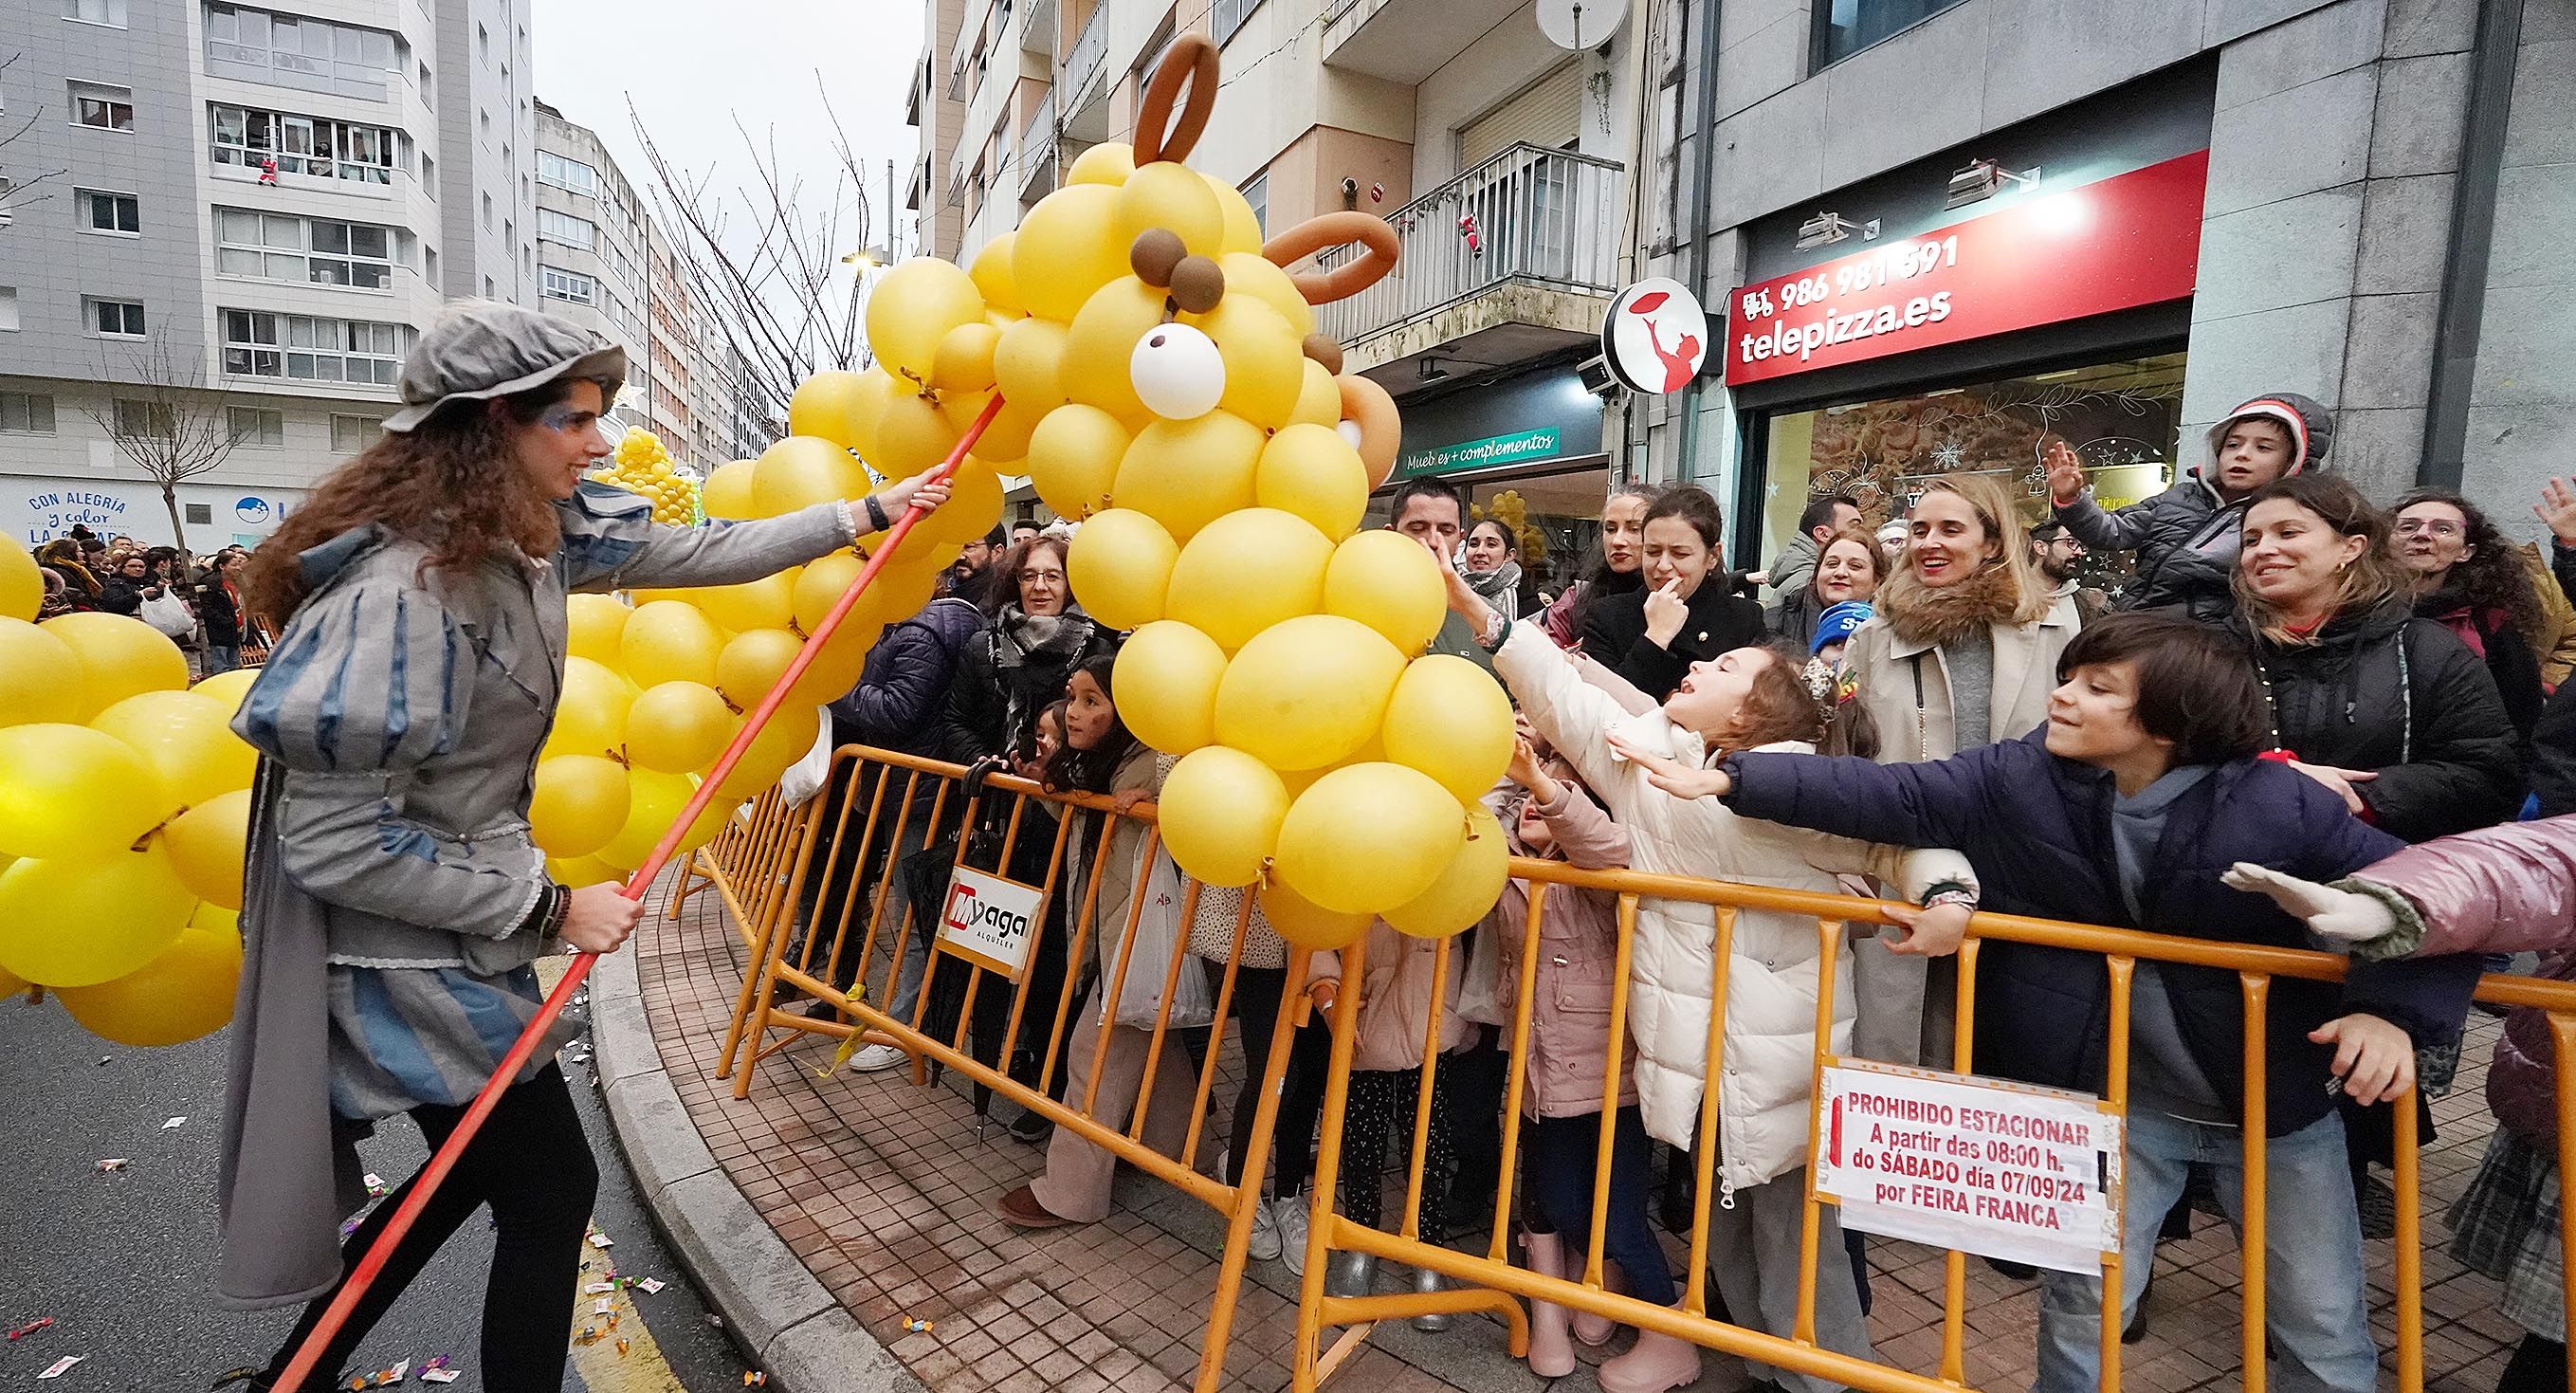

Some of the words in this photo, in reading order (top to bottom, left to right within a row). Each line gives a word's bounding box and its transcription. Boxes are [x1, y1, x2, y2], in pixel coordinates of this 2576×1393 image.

[1781, 273, 1829, 311] 986
[1836, 248, 1888, 296] 981
[1898, 235, 1958, 280] 591
[1740, 291, 1951, 362] telepizza.es
[1459, 433, 1555, 463] complementos
[28, 492, 60, 510] CON
[66, 492, 126, 514] ALEGRÍA
[48, 513, 59, 528] y
[65, 508, 110, 523] color
[29, 529, 50, 543] LA
[948, 890, 1027, 938] Myaga
[977, 931, 1014, 949] ALQUILER
[1848, 1091, 1953, 1127] PROHIBIDO
[1959, 1107, 2091, 1147] ESTACIONAR
[1870, 1123, 1884, 1144] A
[1889, 1129, 1941, 1152] partir
[1946, 1135, 1980, 1159] das
[1986, 1140, 2039, 1167] 08:00
[2046, 1148, 2064, 1172] h.
[1853, 1147, 1874, 1169] do
[1880, 1148, 1960, 1183] SÁBADO
[1965, 1165, 1995, 1190] día
[2001, 1170, 2086, 1202] 07/09/24
[1875, 1182, 1906, 1204] por
[1911, 1184, 1969, 1215] FEIRA
[1976, 1195, 2060, 1230] FRANCA
